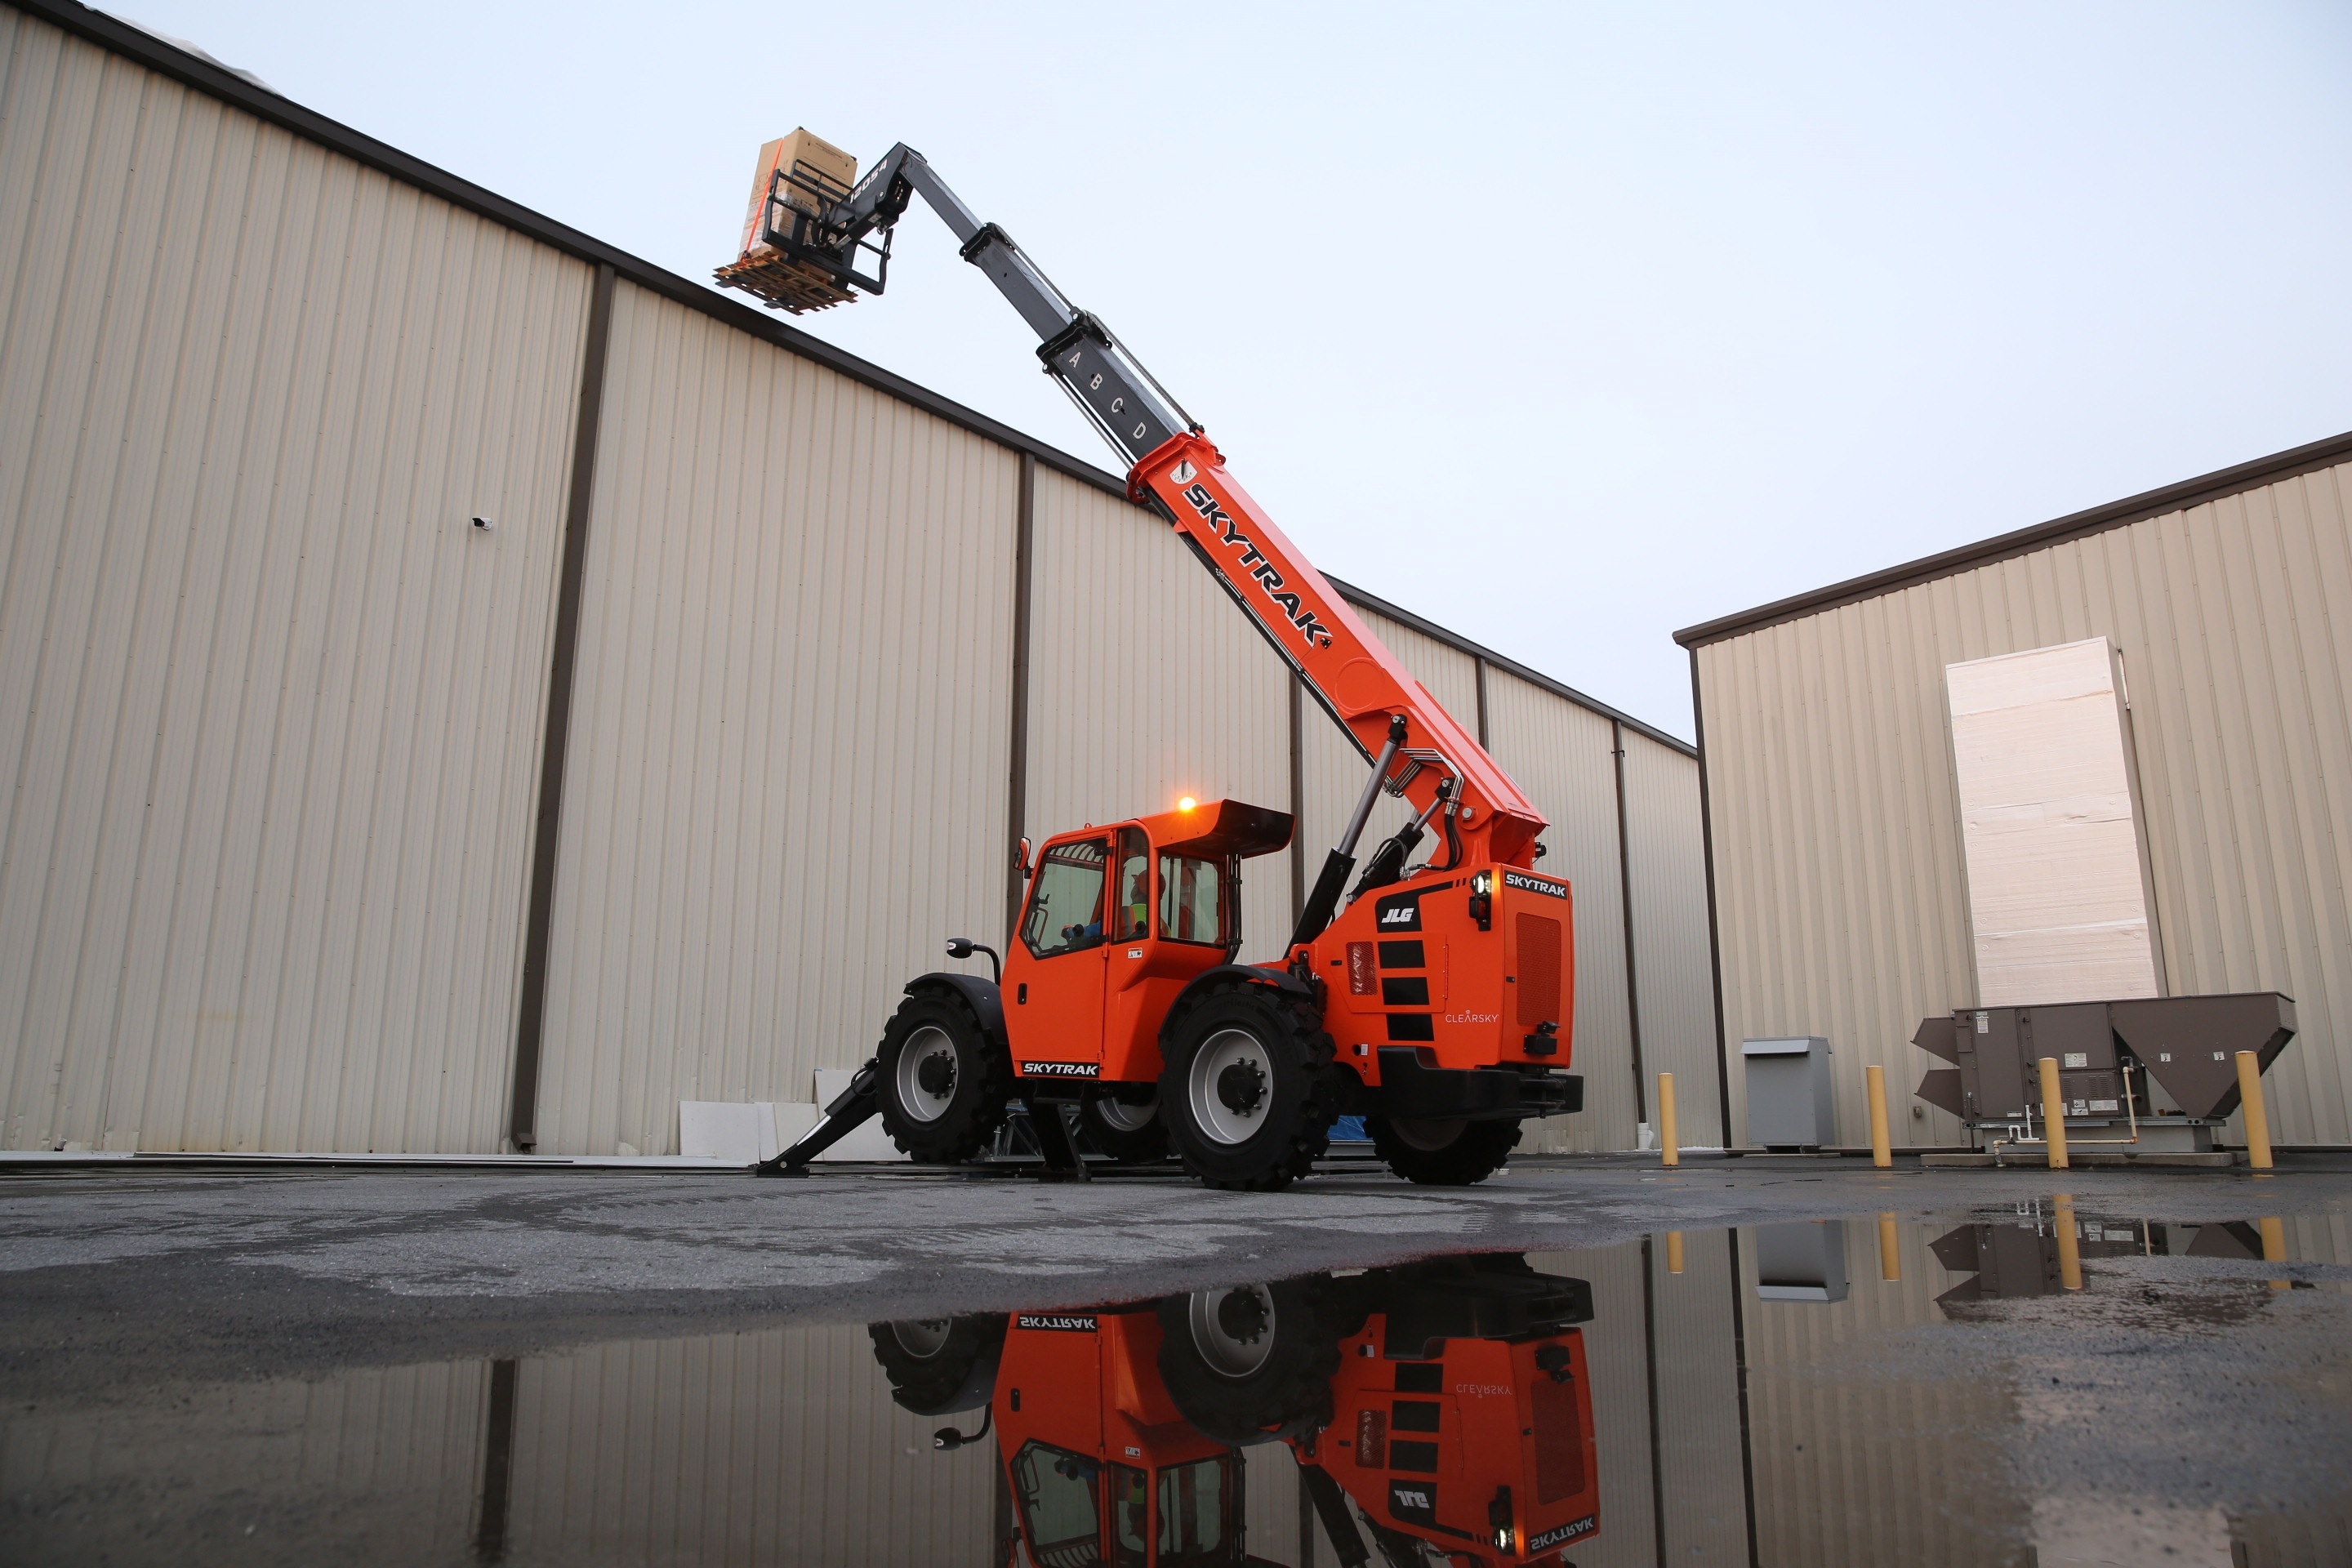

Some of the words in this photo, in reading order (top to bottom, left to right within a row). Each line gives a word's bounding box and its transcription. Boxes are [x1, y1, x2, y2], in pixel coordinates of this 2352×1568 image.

[1069, 352, 1081, 368] A
[1090, 373, 1102, 390] B
[1111, 397, 1124, 413] C
[1133, 421, 1147, 439] D
[1182, 483, 1333, 648] SKYTRAK
[1505, 874, 1566, 897] SKYTRAK
[1382, 907, 1414, 923] JLG
[1445, 1013, 1498, 1023] CLEARSKY
[1023, 1062, 1098, 1076] SKYTRAK
